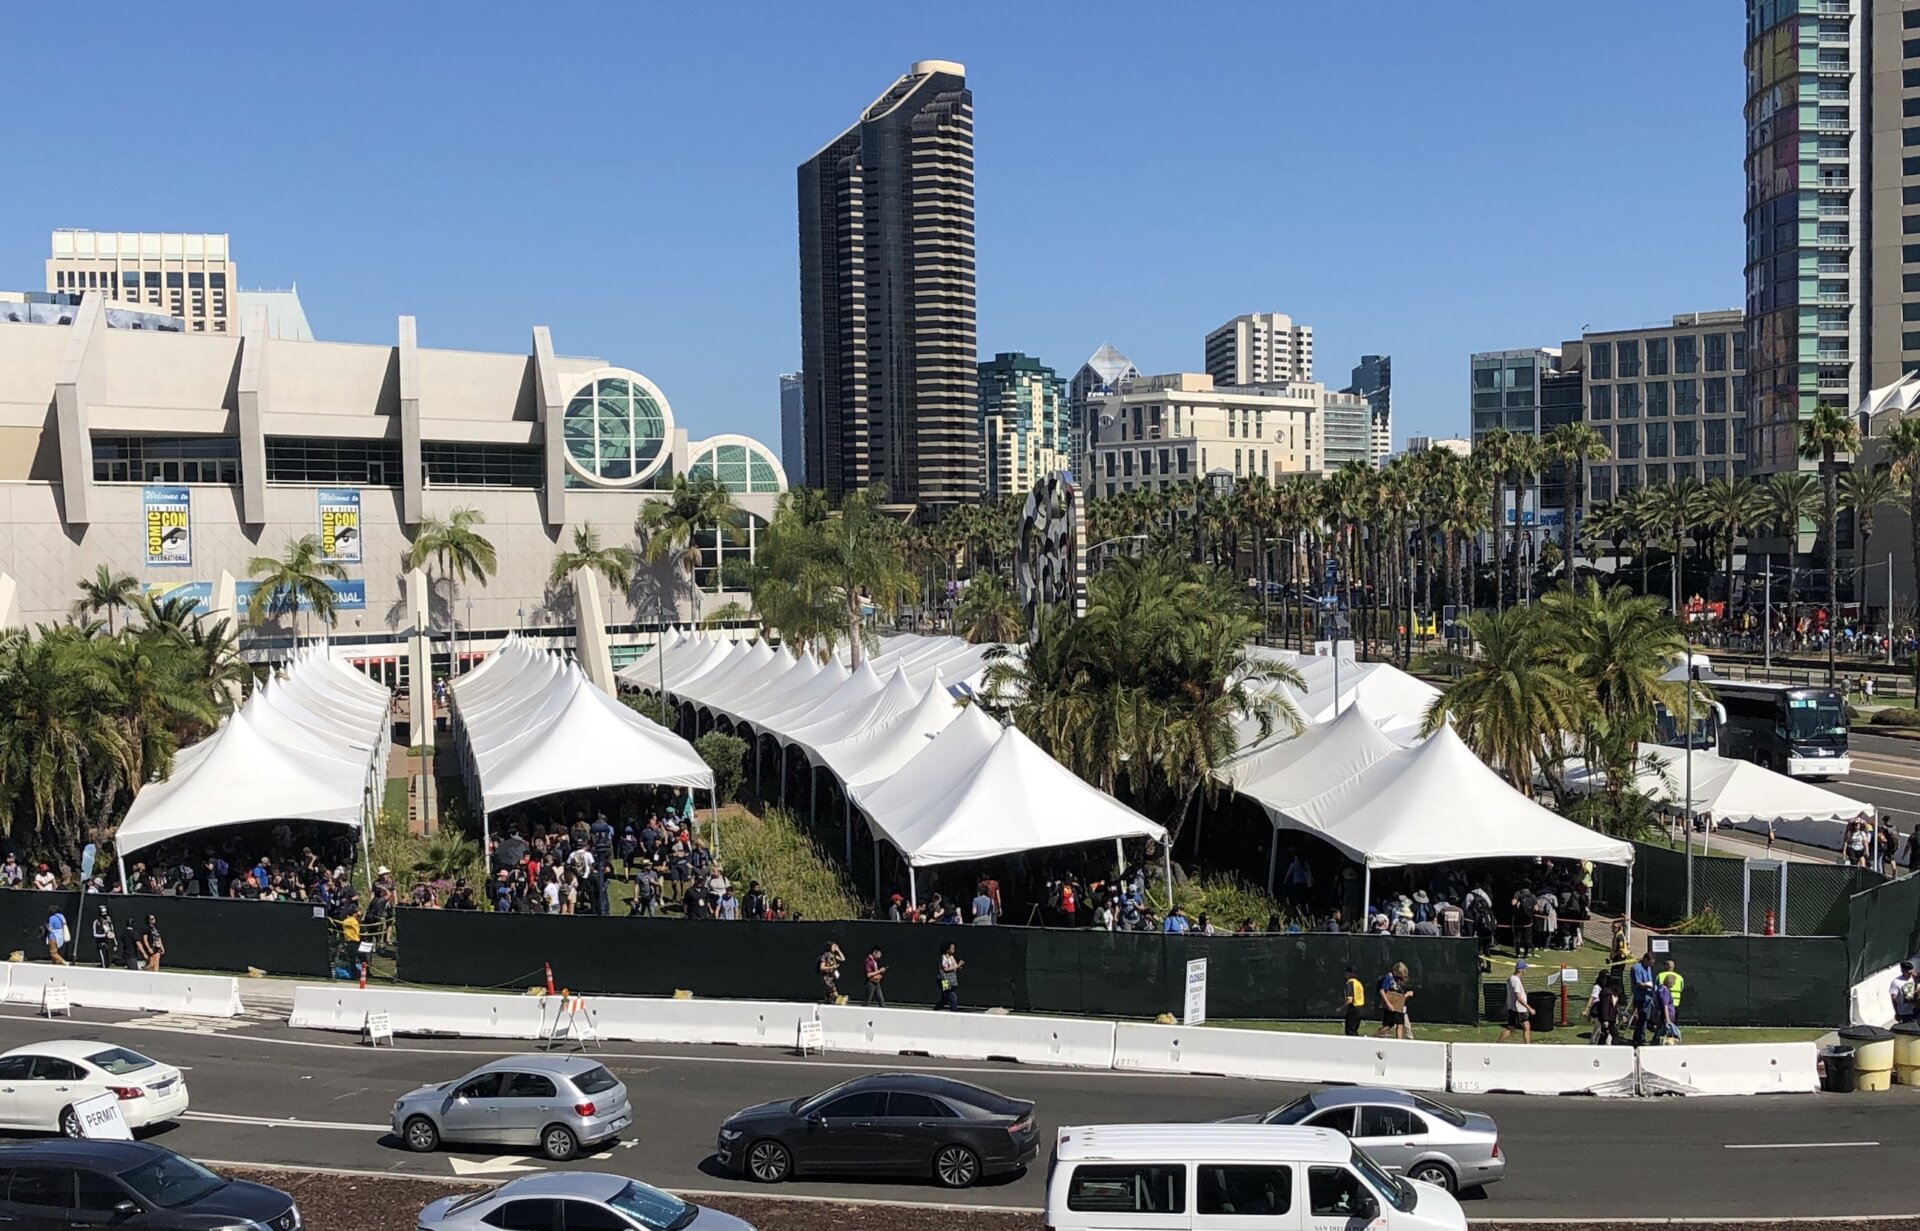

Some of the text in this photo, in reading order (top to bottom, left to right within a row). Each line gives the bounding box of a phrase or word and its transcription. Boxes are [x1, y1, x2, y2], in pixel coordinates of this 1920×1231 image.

[145, 491, 179, 500] Welcome
[320, 493, 350, 502] Welcome
[162, 512, 186, 526] CON
[335, 513, 357, 527] CON
[148, 512, 162, 554] COMIC
[323, 513, 336, 553] COMIC
[1189, 972, 1205, 984] CLOSED
[86, 1106, 118, 1127] PERMIT
